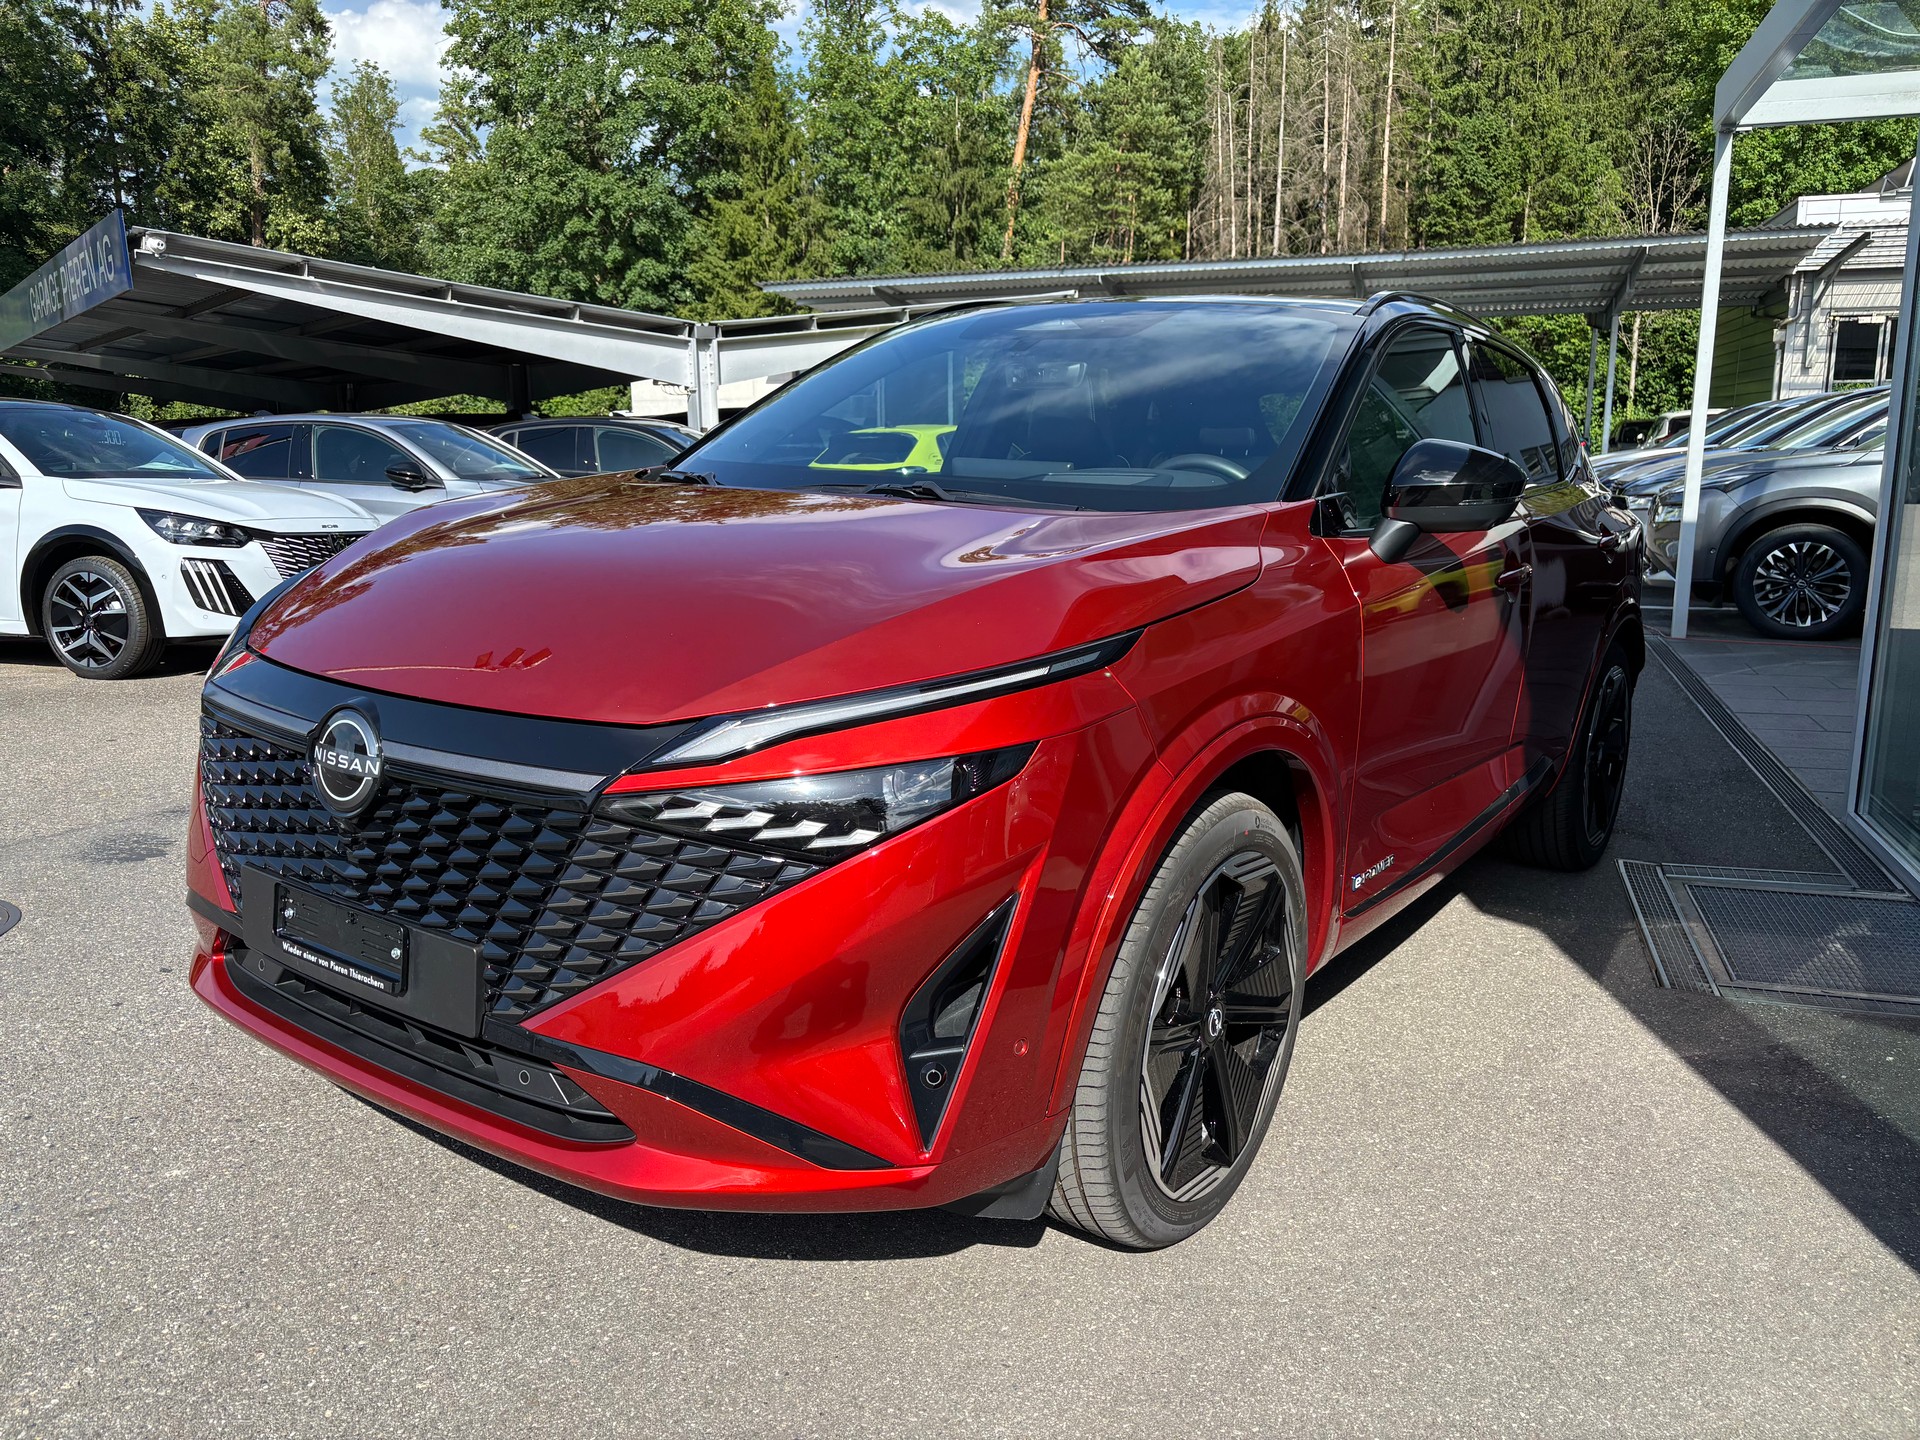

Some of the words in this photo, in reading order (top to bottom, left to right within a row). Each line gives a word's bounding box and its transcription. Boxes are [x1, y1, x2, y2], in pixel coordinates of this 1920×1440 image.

[29, 270, 62, 323] GARAGE
[60, 246, 97, 306] PIEREN
[97, 234, 115, 284] AG
[314, 745, 380, 775] NISSAN
[282, 941, 302, 957] Wieder
[303, 951, 317, 963] einer
[318, 958, 329, 968] von
[329, 960, 348, 976] Pieren
